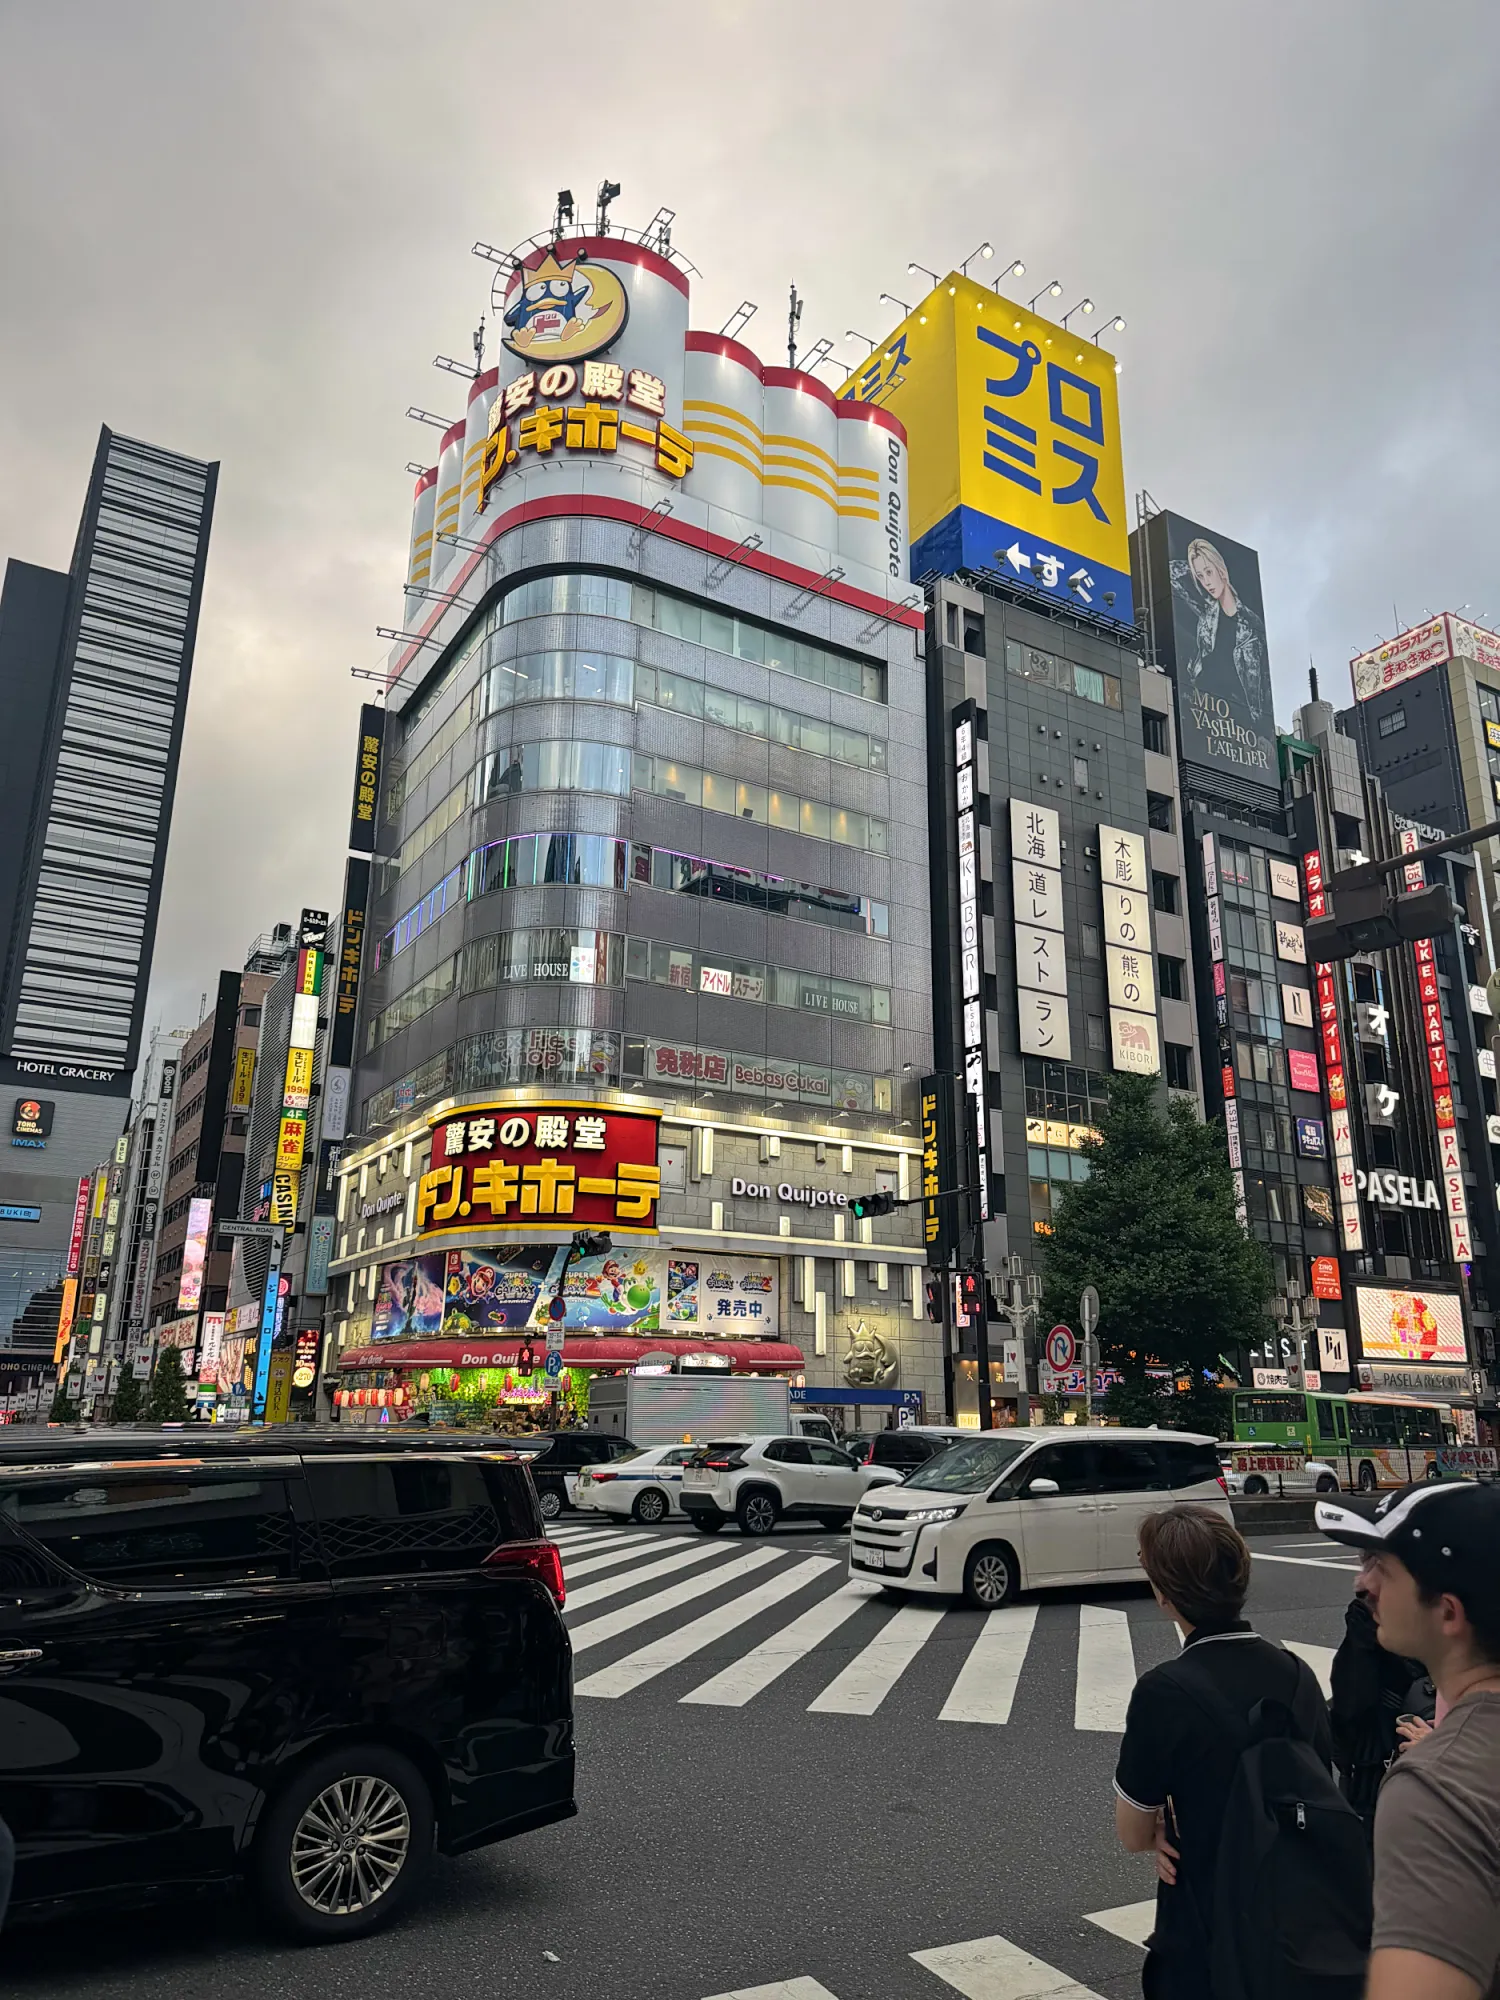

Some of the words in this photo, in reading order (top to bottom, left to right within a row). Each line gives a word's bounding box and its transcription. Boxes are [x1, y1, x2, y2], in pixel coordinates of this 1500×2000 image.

[842, 332, 911, 401] ミス
[976, 325, 1106, 447] プロ
[886, 436, 900, 486] Don
[982, 405, 1113, 525] ミス
[887, 489, 904, 579] Quijote
[1035, 552, 1096, 604] すぐ
[1388, 626, 1433, 658] カラオケ
[1383, 640, 1446, 684] まねきねこ
[1191, 688, 1231, 720] MIO
[1190, 708, 1258, 748] YASHIRO
[1206, 736, 1270, 770] L'ATELIER
[356, 735, 382, 821] 驚安の殿堂
[1305, 855, 1326, 910] カラオ
[1407, 870, 1421, 880] OK
[961, 858, 976, 992] KIBORI
[1026, 812, 1055, 1048] 北海道レストラン
[1114, 837, 1141, 1003] 木彫りの熊の
[503, 964, 528, 980] LIVE
[533, 962, 569, 977] HOUSE
[669, 963, 692, 988] 新宿
[702, 970, 731, 993] アイドル
[734, 976, 763, 998] ステージ
[1424, 985, 1435, 996] &
[804, 992, 828, 1009] LIVE
[831, 997, 859, 1015] HOUSE
[1427, 1006, 1445, 1073] PARTY
[16, 1061, 57, 1076] HOTEL
[59, 1066, 116, 1082] GRACERY
[239, 1051, 249, 1078] 生ビール
[292, 1051, 304, 1083] 生ビール
[655, 1046, 729, 1084] 免税店
[1119, 1048, 1154, 1065] KIBORI
[163, 1065, 176, 1095] Booth
[287, 1085, 309, 1094] 199円
[734, 1063, 785, 1090] Bebas
[16, 1120, 37, 1128] TOHO
[159, 1101, 168, 1135] ネットカフェ
[286, 1110, 303, 1118] 4F
[11, 1138, 47, 1149] IMAX
[16, 1126, 43, 1135] CINEMAS
[282, 1121, 303, 1155] 麻雀
[444, 1115, 607, 1156] 驚安の殿堂
[153, 1144, 164, 1167] カプセル
[731, 1177, 771, 1199] Don
[777, 1184, 848, 1210] Quijote
[1335, 1126, 1360, 1234] パセラ
[1357, 1169, 1442, 1211] PASELA
[275, 1174, 294, 1229] CASINO
[362, 1199, 375, 1218] Don
[376, 1191, 405, 1214] Quijote
[1442, 1135, 1470, 1257] PASELA
[144, 1202, 158, 1233] Booth
[495, 1285, 536, 1296] GALAXY
[548, 1284, 587, 1296] GAXY
[585, 1278, 602, 1296] 2
[563, 1277, 585, 1286] RIO
[717, 1298, 762, 1318] 発売中
[461, 1353, 488, 1365] Don
[491, 1353, 540, 1366] Quije
[548, 1357, 556, 1373] P
[1383, 1372, 1424, 1387] PASELA
[1424, 1374, 1470, 1389] RESORTS
[904, 1393, 910, 1403] P
[900, 1409, 909, 1427] P
